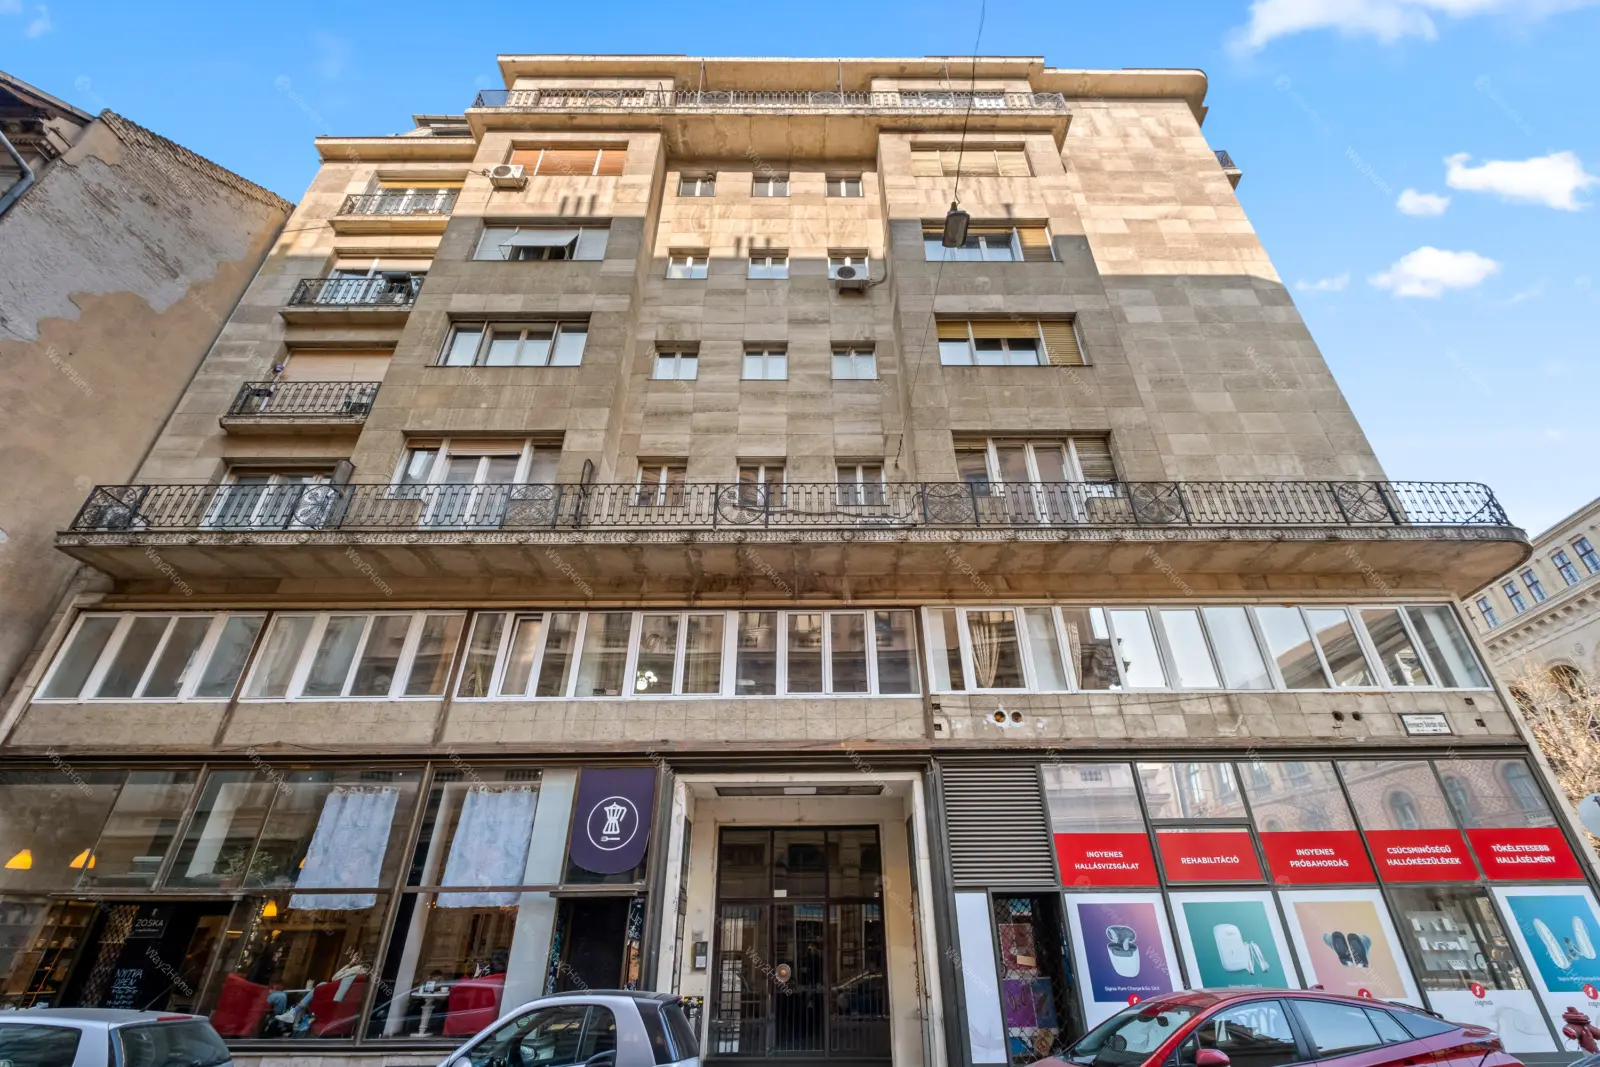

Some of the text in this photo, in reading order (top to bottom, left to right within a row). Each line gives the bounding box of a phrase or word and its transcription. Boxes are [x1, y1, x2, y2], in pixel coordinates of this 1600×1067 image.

[1295, 848, 1335, 856] INGYENES
[1491, 843, 1550, 852] TÖKÉLETESEBB
[1181, 855, 1240, 864] REHABILITÁCIÓ
[1289, 858, 1349, 868] PRÓBAHORDÁS
[1386, 857, 1462, 866] HALLÓKÉSZÜLÉKEK
[1495, 855, 1556, 864] HALLÁSÉLMÉNY
[1074, 862, 1139, 870] HALLÁSVIZSGÁLAT
[114, 978, 137, 987] OPEN
